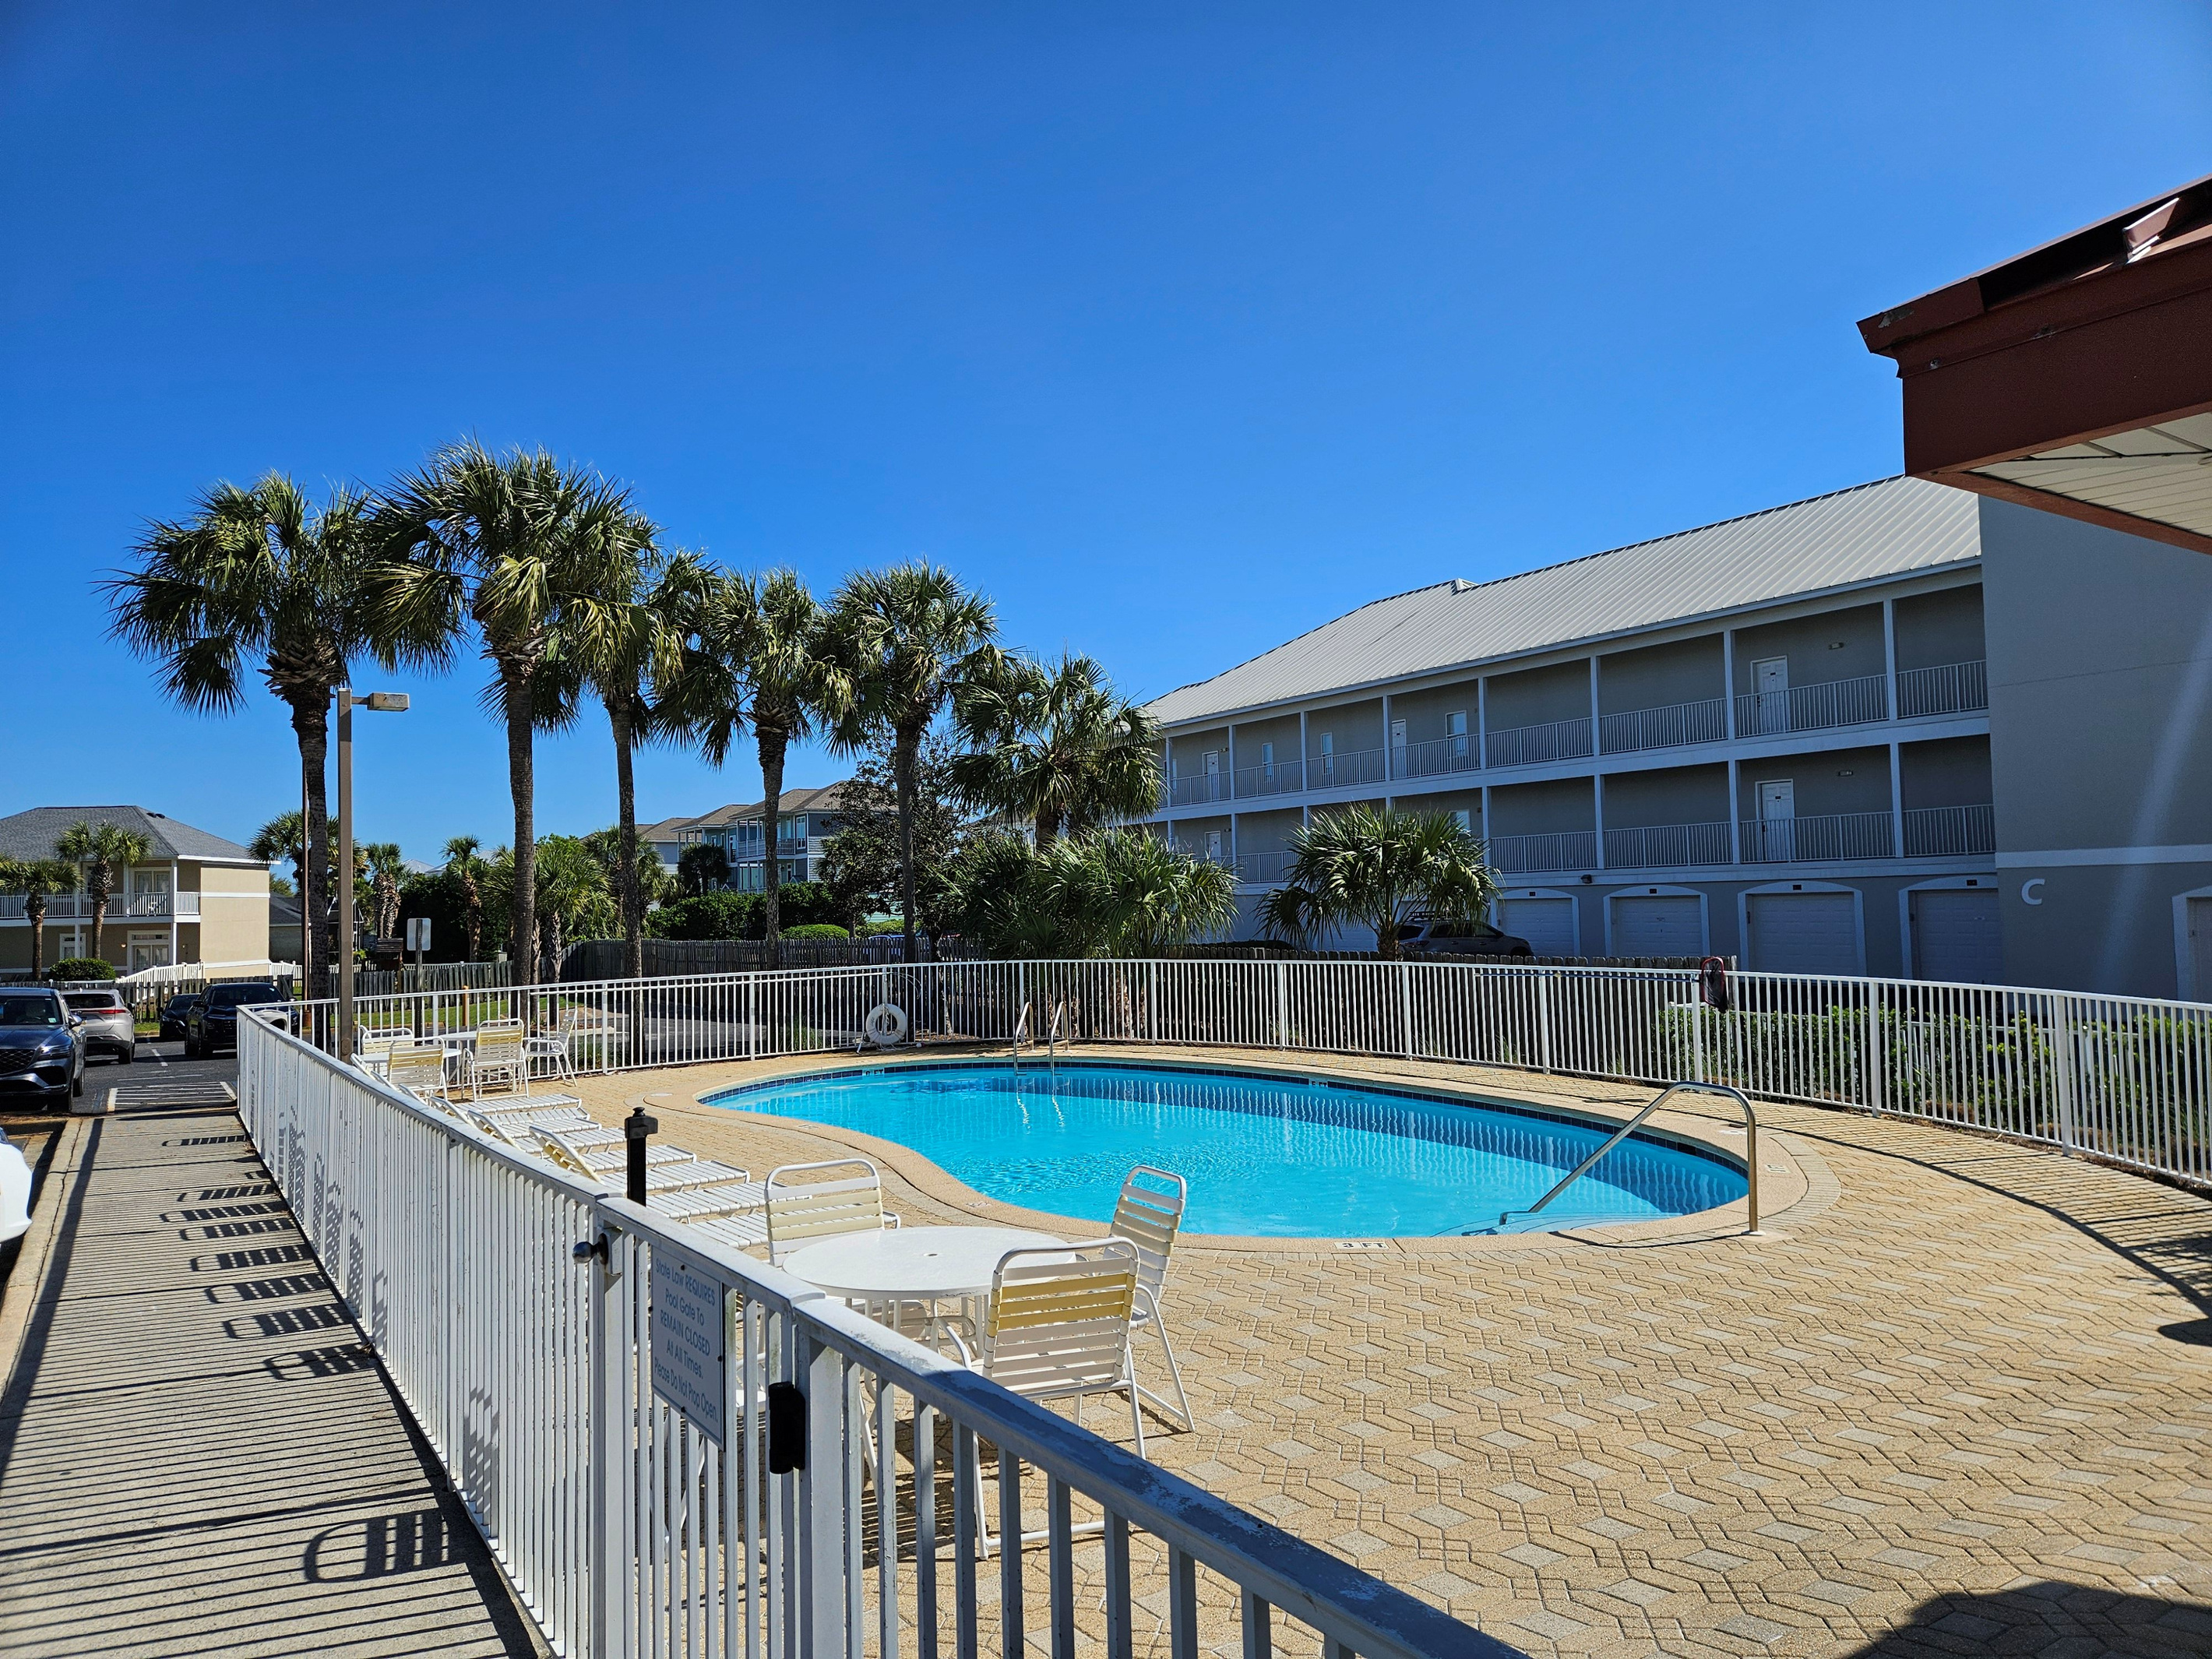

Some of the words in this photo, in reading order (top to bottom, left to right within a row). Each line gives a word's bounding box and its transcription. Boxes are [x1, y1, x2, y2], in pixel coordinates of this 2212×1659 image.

[2021, 878, 2045, 905] C
[656, 1258, 670, 1280] State
[671, 1266, 685, 1287] Law
[685, 1274, 715, 1307] REQUIRES
[665, 1287, 678, 1309] Pool
[680, 1297, 696, 1321] Gate
[660, 1309, 684, 1338] REMAIN
[685, 1326, 710, 1356] CLOSED
[667, 1339, 673, 1357] At
[684, 1350, 703, 1379] Times.
[654, 1357, 670, 1383] Please
[670, 1368, 678, 1390] Do
[678, 1375, 687, 1398] Not
[688, 1382, 700, 1411] Prop
[701, 1393, 718, 1423] Open.
